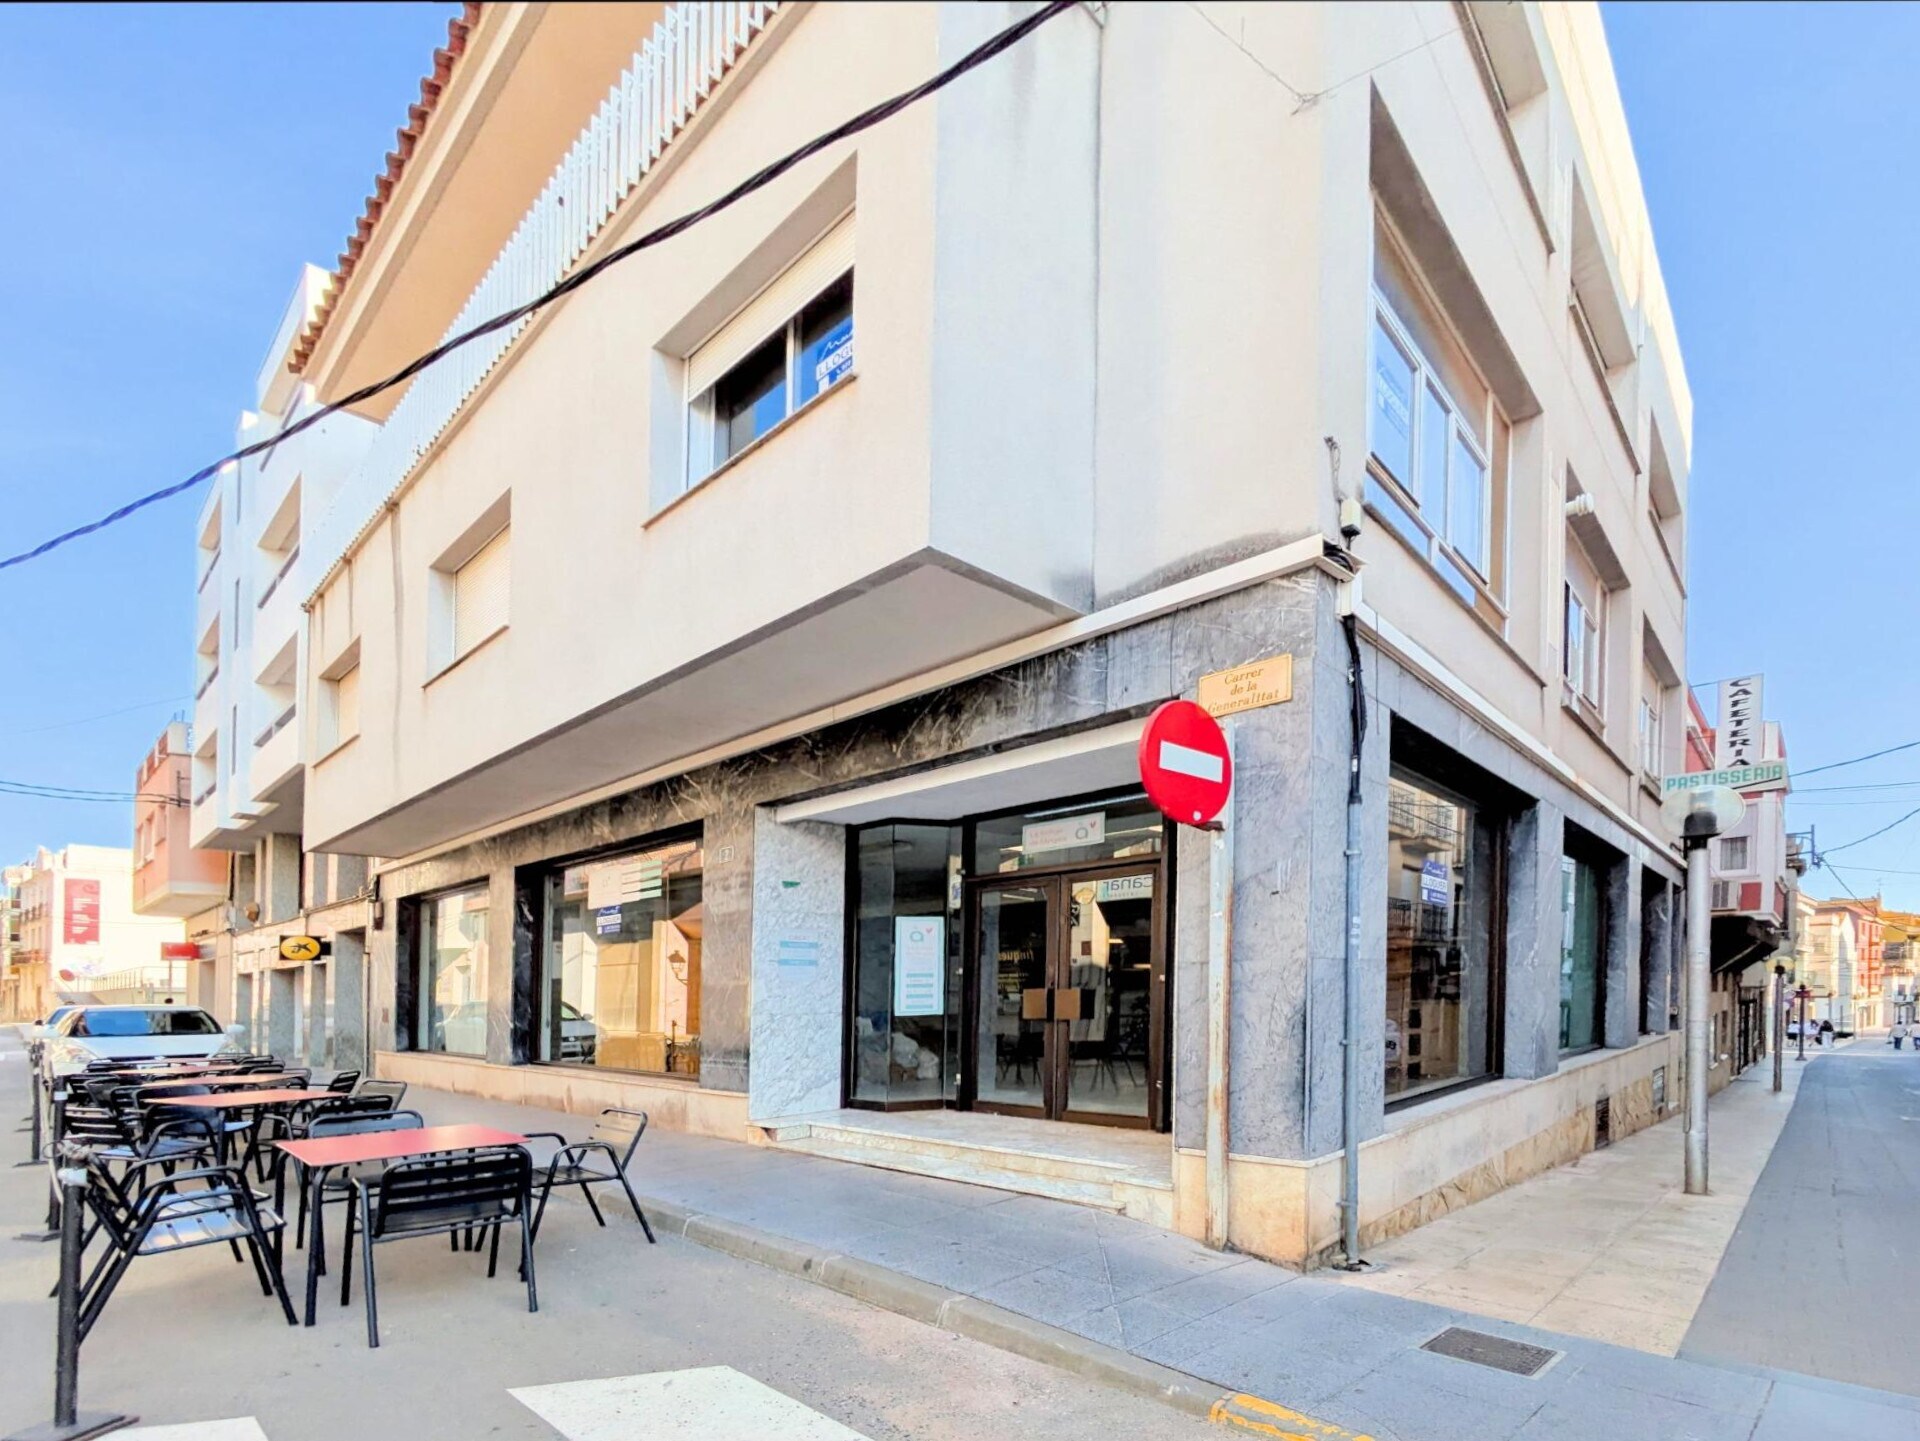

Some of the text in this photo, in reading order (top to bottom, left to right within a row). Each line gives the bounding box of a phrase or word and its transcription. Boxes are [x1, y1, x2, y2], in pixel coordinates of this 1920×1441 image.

[1224, 668, 1264, 685] Carrer
[1230, 680, 1257, 696] de la
[1727, 677, 1752, 768] CAFETERIA
[1666, 765, 1783, 791] PASTISSERIA
